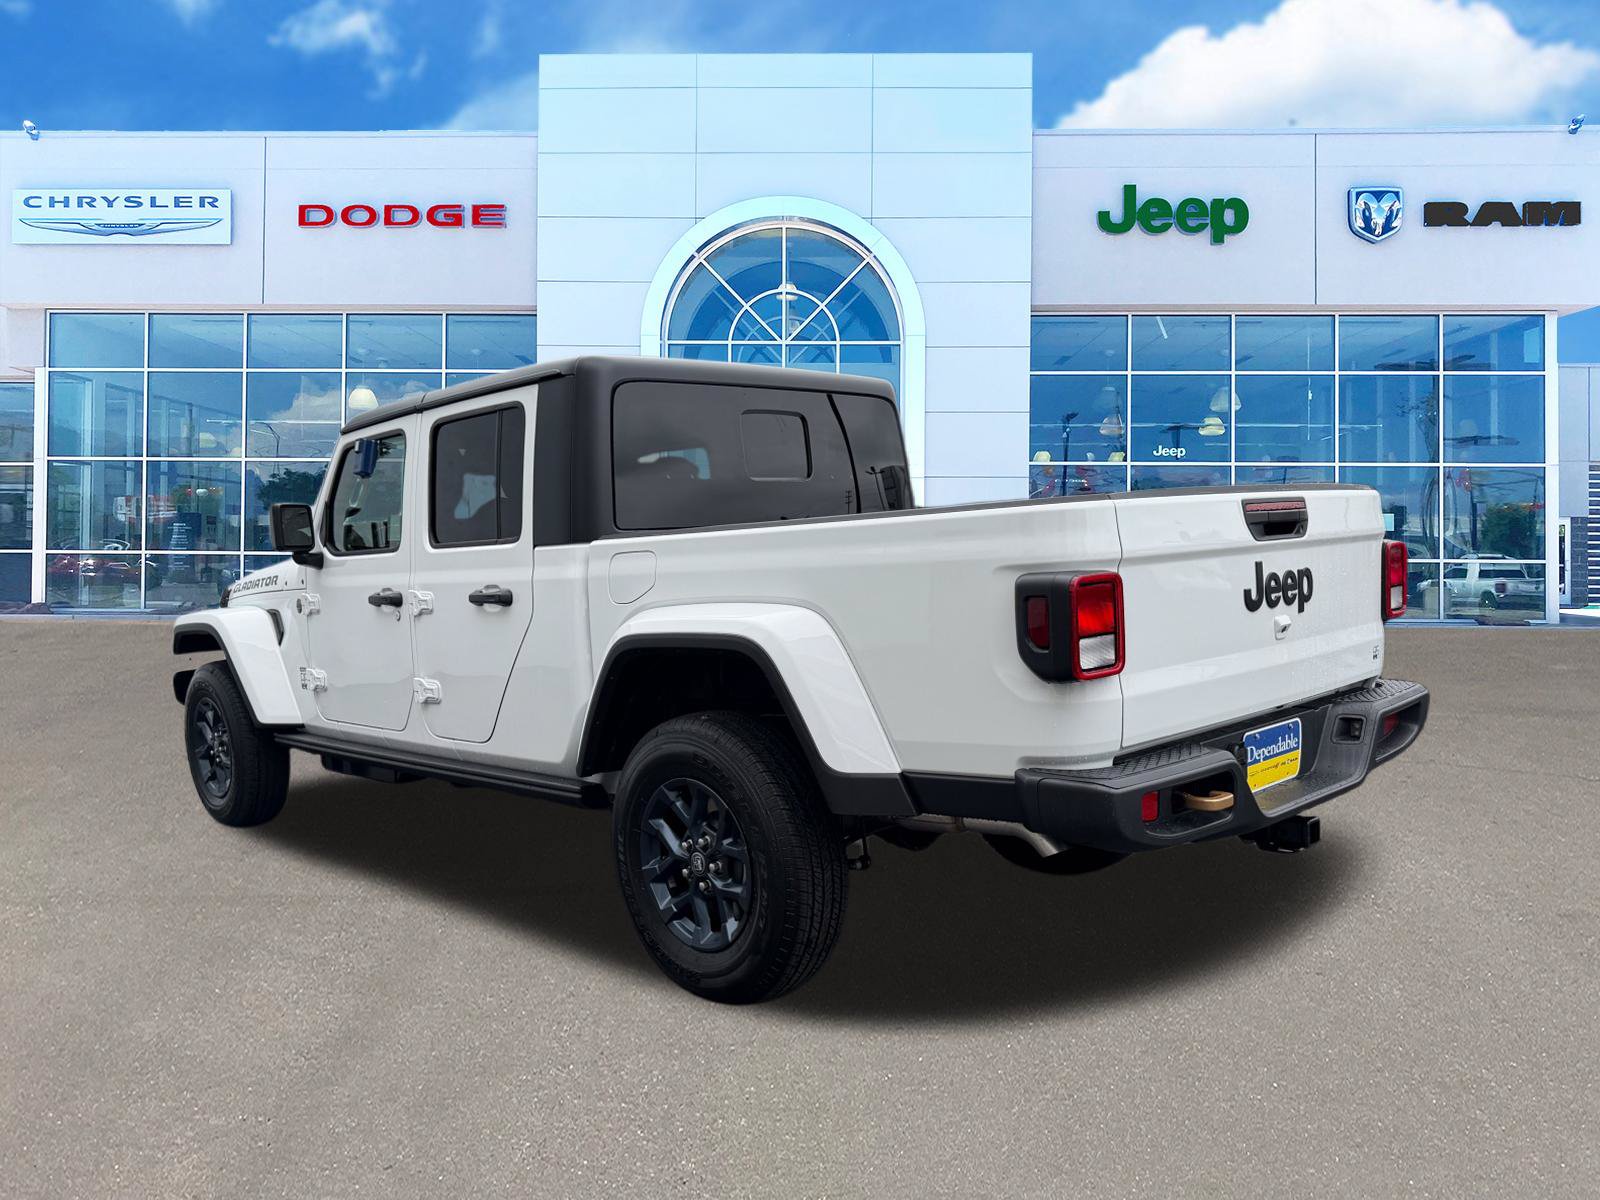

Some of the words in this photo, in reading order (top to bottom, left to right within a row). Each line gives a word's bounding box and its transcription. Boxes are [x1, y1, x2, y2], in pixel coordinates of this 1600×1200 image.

[23, 194, 219, 209] CHRYSLER
[1098, 184, 1249, 244] Jeep
[1422, 200, 1582, 228] RAM
[298, 203, 507, 229] DODGE
[1152, 444, 1187, 458] Jeep
[232, 575, 279, 594] GLADIATOR
[1243, 560, 1314, 614] Jeep
[1246, 733, 1298, 763] Dependable
